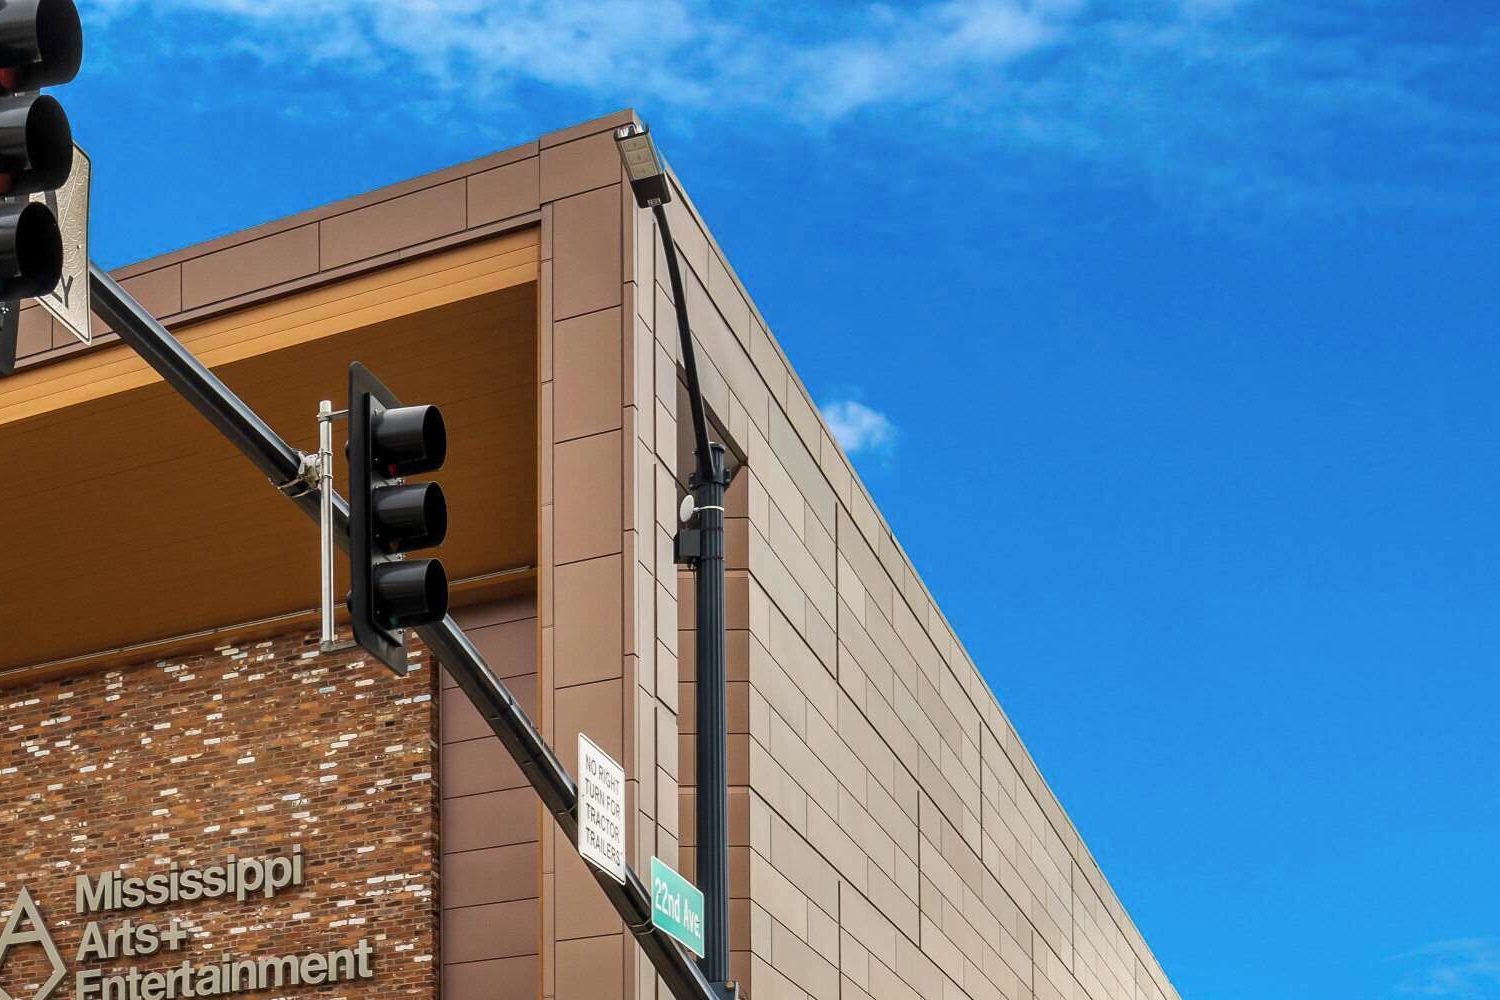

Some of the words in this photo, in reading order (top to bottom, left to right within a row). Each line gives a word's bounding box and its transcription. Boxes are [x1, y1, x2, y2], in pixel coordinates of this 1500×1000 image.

[585, 754, 597, 776] NO
[599, 765, 620, 795] RIGHT
[585, 777, 604, 805] TURN
[606, 795, 620, 819] FOR
[586, 802, 620, 842] TRACTOR
[586, 827, 620, 866] TRAILERS
[76, 844, 304, 914] Mississippi
[655, 877, 680, 923] 22nd
[76, 919, 188, 962] Arts+
